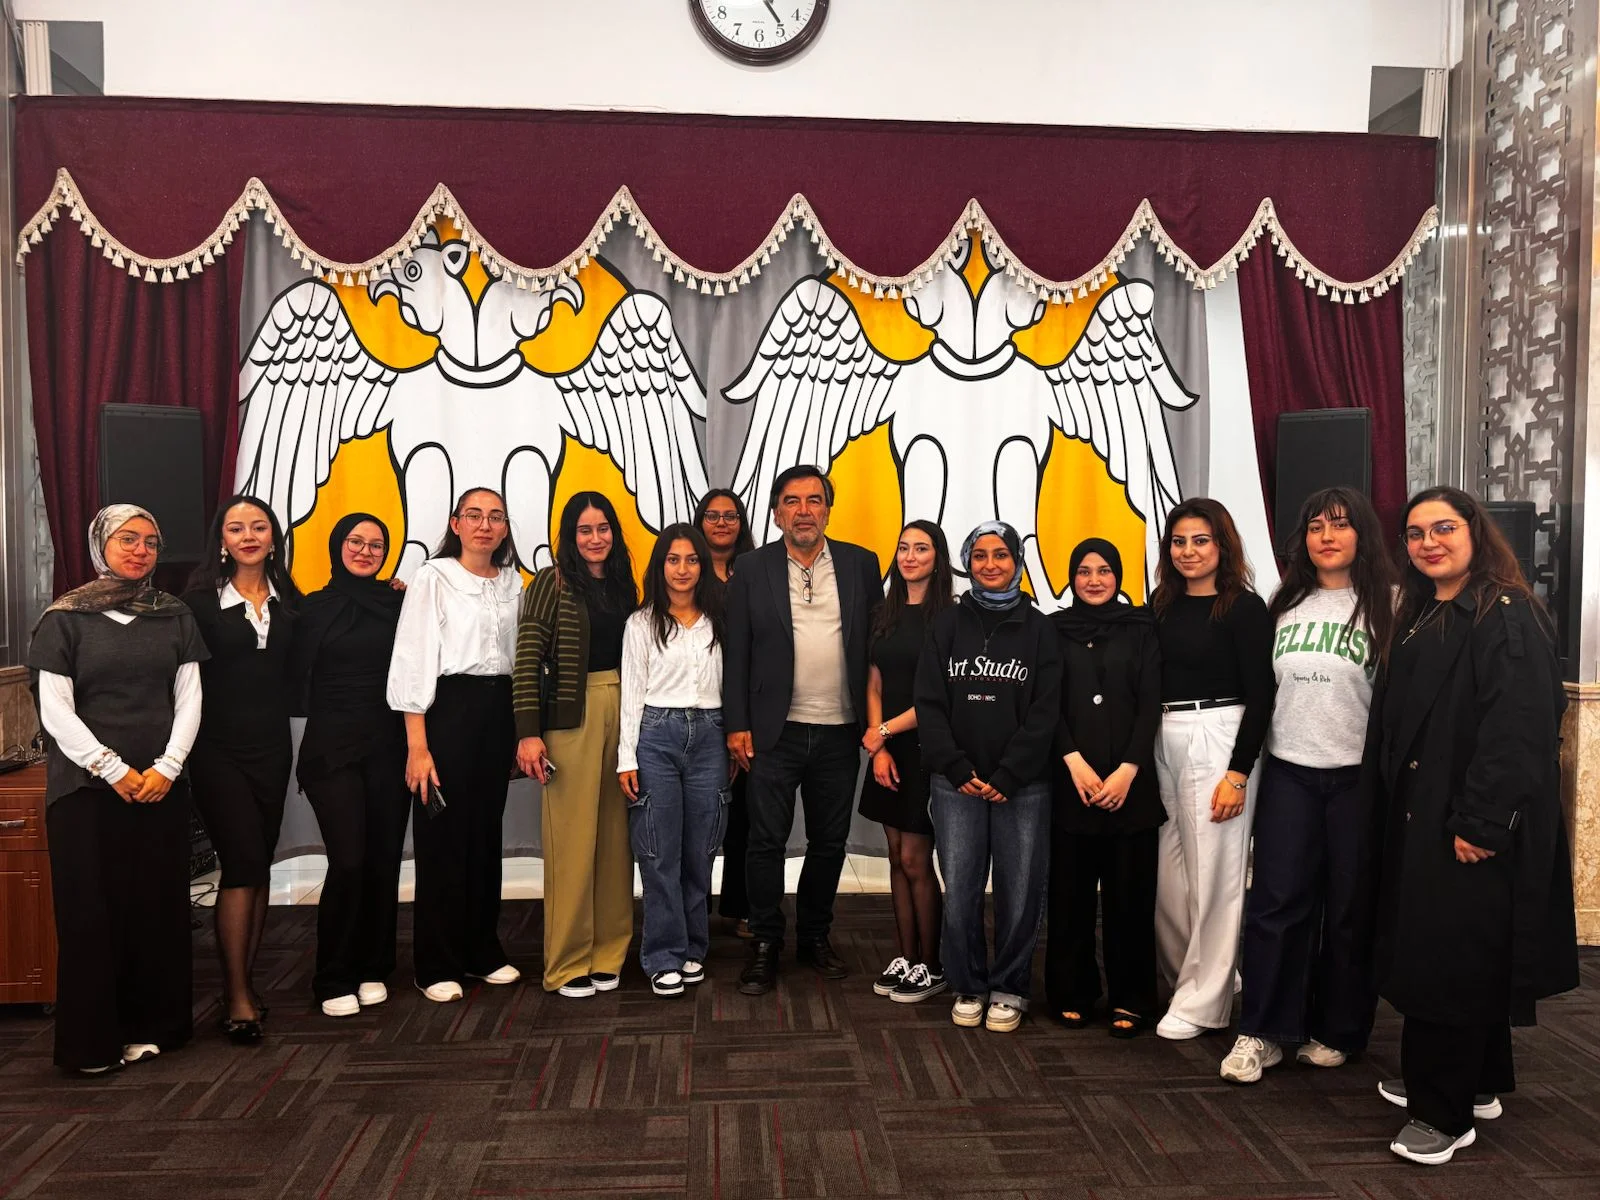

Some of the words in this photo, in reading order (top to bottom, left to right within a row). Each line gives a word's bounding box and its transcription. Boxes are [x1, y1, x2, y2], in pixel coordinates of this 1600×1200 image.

[717, 5, 727, 19] 8
[791, 8, 801, 21] 4
[733, 23, 742, 35] 7
[754, 29, 764, 42] 6
[776, 23, 785, 37] 5
[948, 656, 968, 677] Art
[970, 655, 1028, 681] Studio
